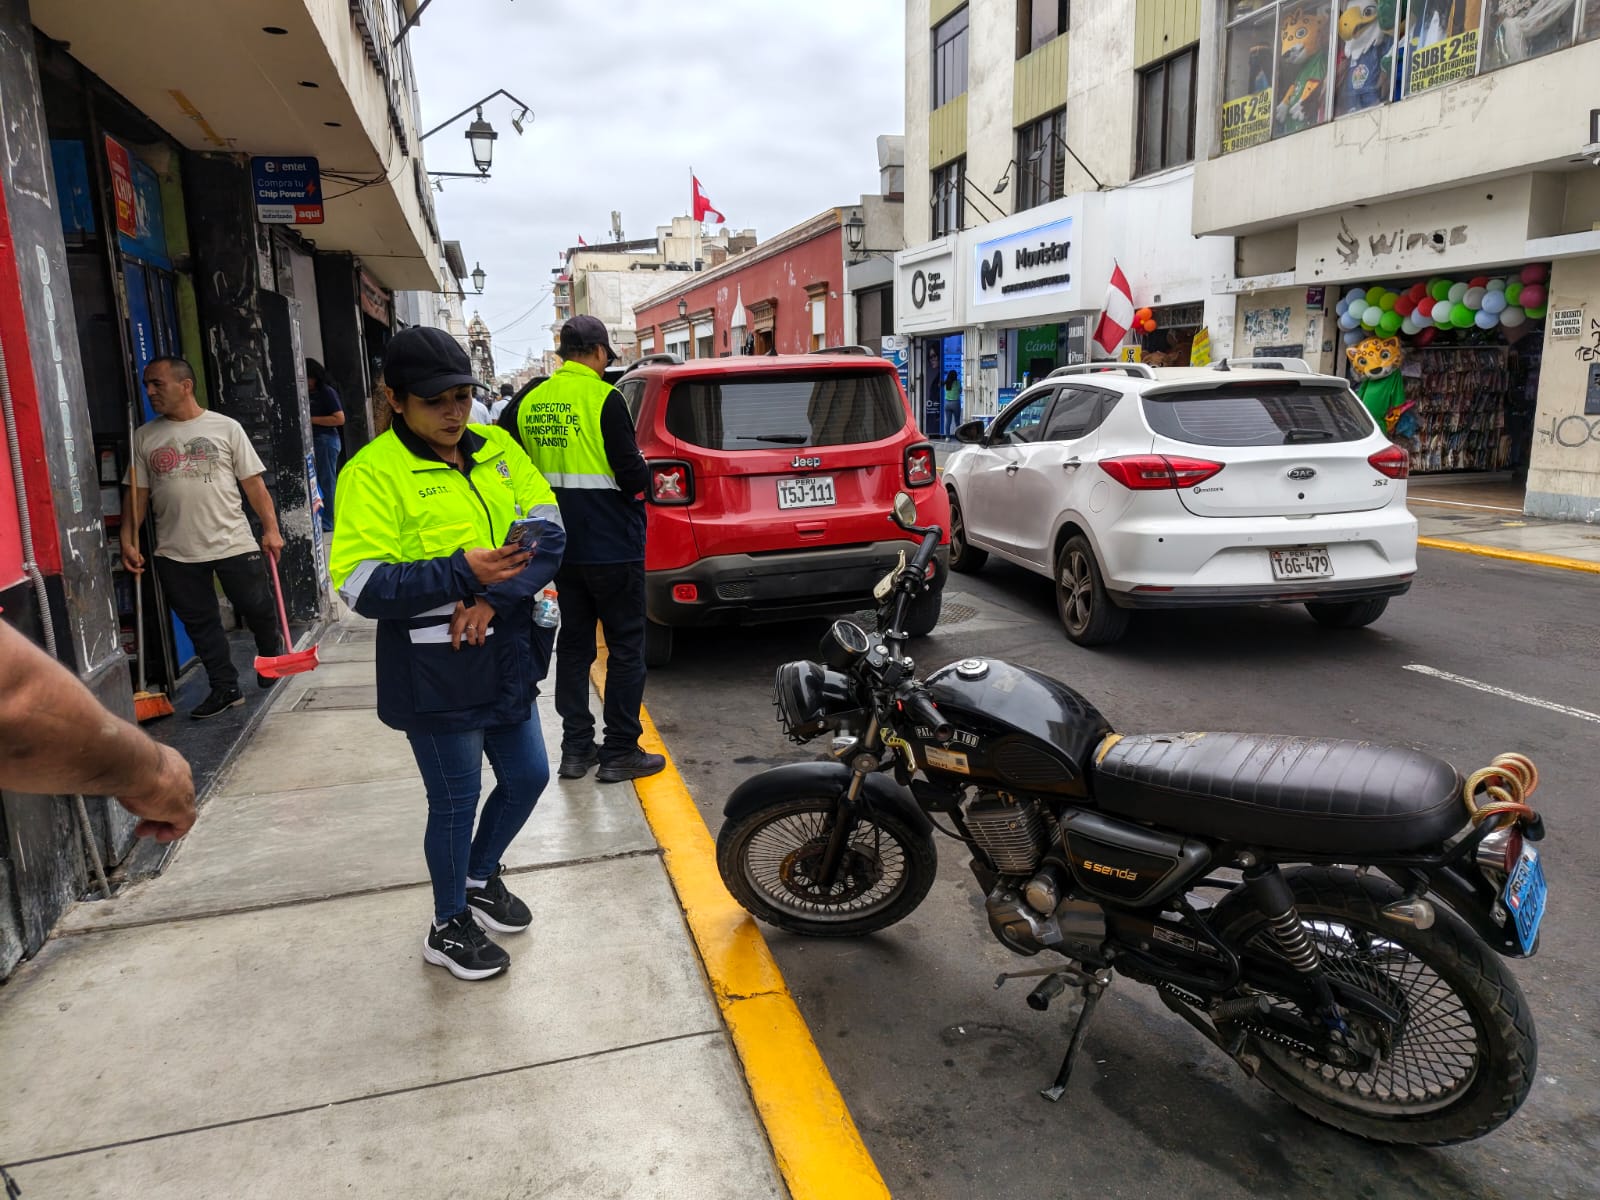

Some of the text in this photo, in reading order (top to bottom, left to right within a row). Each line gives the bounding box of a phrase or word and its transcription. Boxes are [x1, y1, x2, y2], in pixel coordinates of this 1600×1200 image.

[1412, 43, 1447, 73] SUBE
[1411, 65, 1440, 83] ESTAMOS
[281, 162, 307, 171] entel
[257, 178, 304, 188] Compra tu
[258, 190, 306, 199] Chip Power
[1015, 241, 1071, 270] Movistar
[530, 402, 572, 413] INSPECTOR
[525, 413, 579, 425] MUNICIPAL DE
[524, 425, 581, 437] TRANSPORTE Y
[791, 455, 821, 469] Jeep
[795, 478, 816, 486] PERU
[780, 482, 835, 503] T5J-111
[1275, 555, 1329, 575] T6G-479
